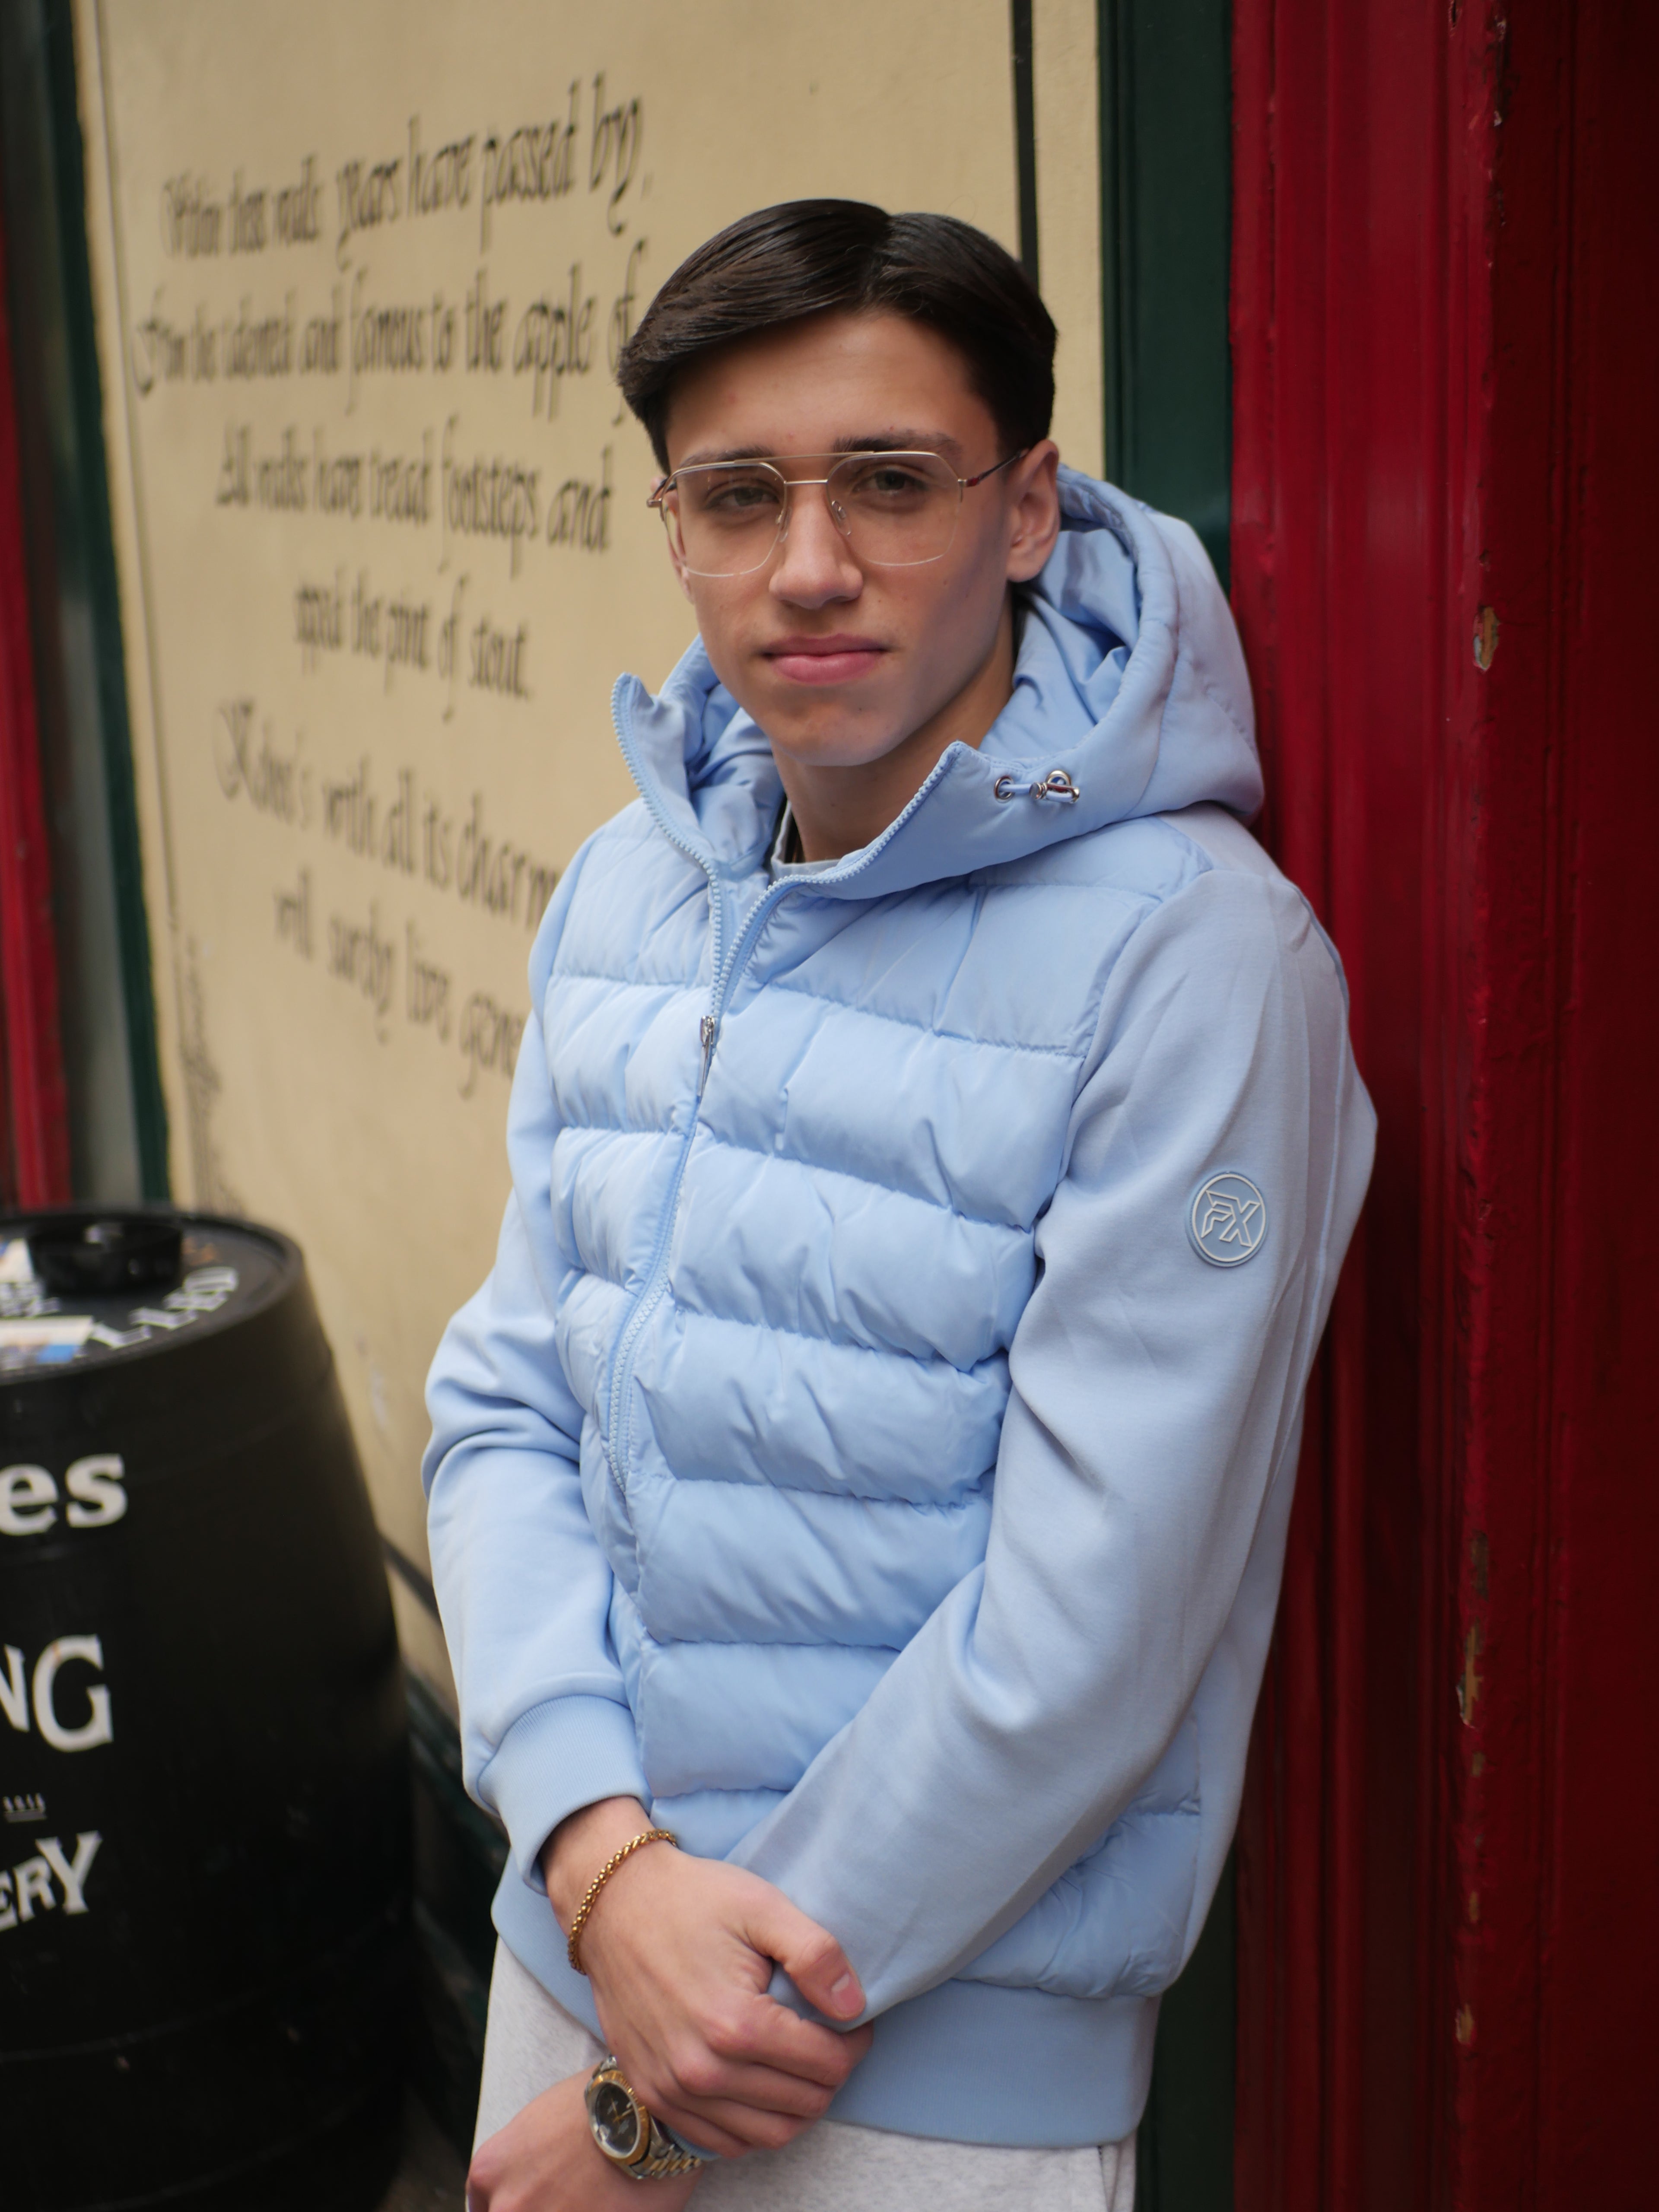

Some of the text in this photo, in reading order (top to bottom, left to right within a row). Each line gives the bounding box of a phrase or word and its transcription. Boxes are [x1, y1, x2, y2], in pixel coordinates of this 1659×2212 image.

[335, 154, 402, 272] years
[407, 113, 475, 219] have
[480, 77, 580, 255] passed
[299, 283, 343, 377] and
[345, 264, 427, 416] famous
[432, 291, 455, 375] to
[464, 266, 507, 373] the
[513, 260, 598, 423] apple
[313, 426, 363, 519] have
[370, 427, 433, 525] tread
[437, 411, 541, 580] footsteps
[547, 442, 613, 555] and
[352, 565, 382, 658] the
[384, 585, 429, 696] pint
[438, 572, 470, 723] of
[468, 613, 533, 701] stout
[381, 766, 415, 877] all
[423, 789, 451, 891] its
